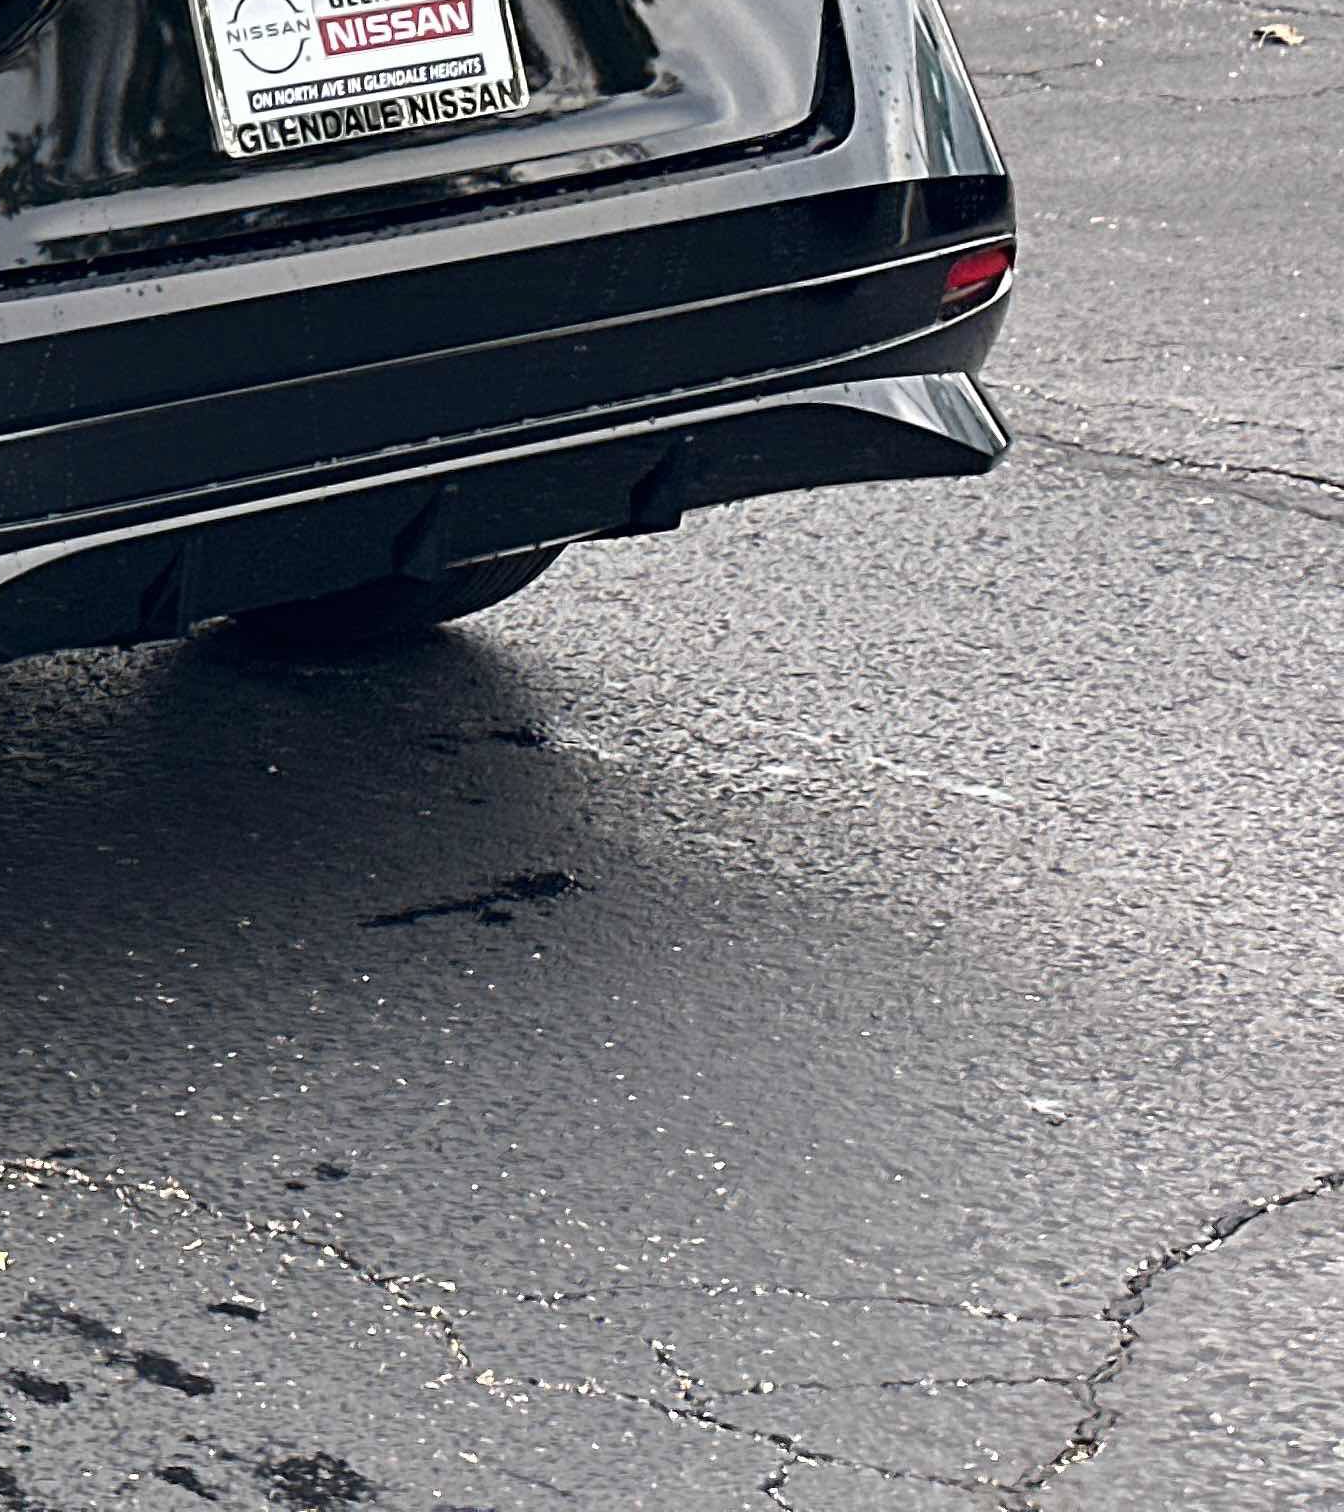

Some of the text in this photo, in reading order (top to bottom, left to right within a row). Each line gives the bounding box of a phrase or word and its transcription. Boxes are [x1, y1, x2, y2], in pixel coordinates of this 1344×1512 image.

[226, 17, 311, 44] NISSAN
[326, 1, 470, 51] NISSAN
[252, 57, 482, 109] ON NORTH AVE IN GLENDALE HEIGHTS
[237, 80, 518, 153] GLENDALE NISSAN
